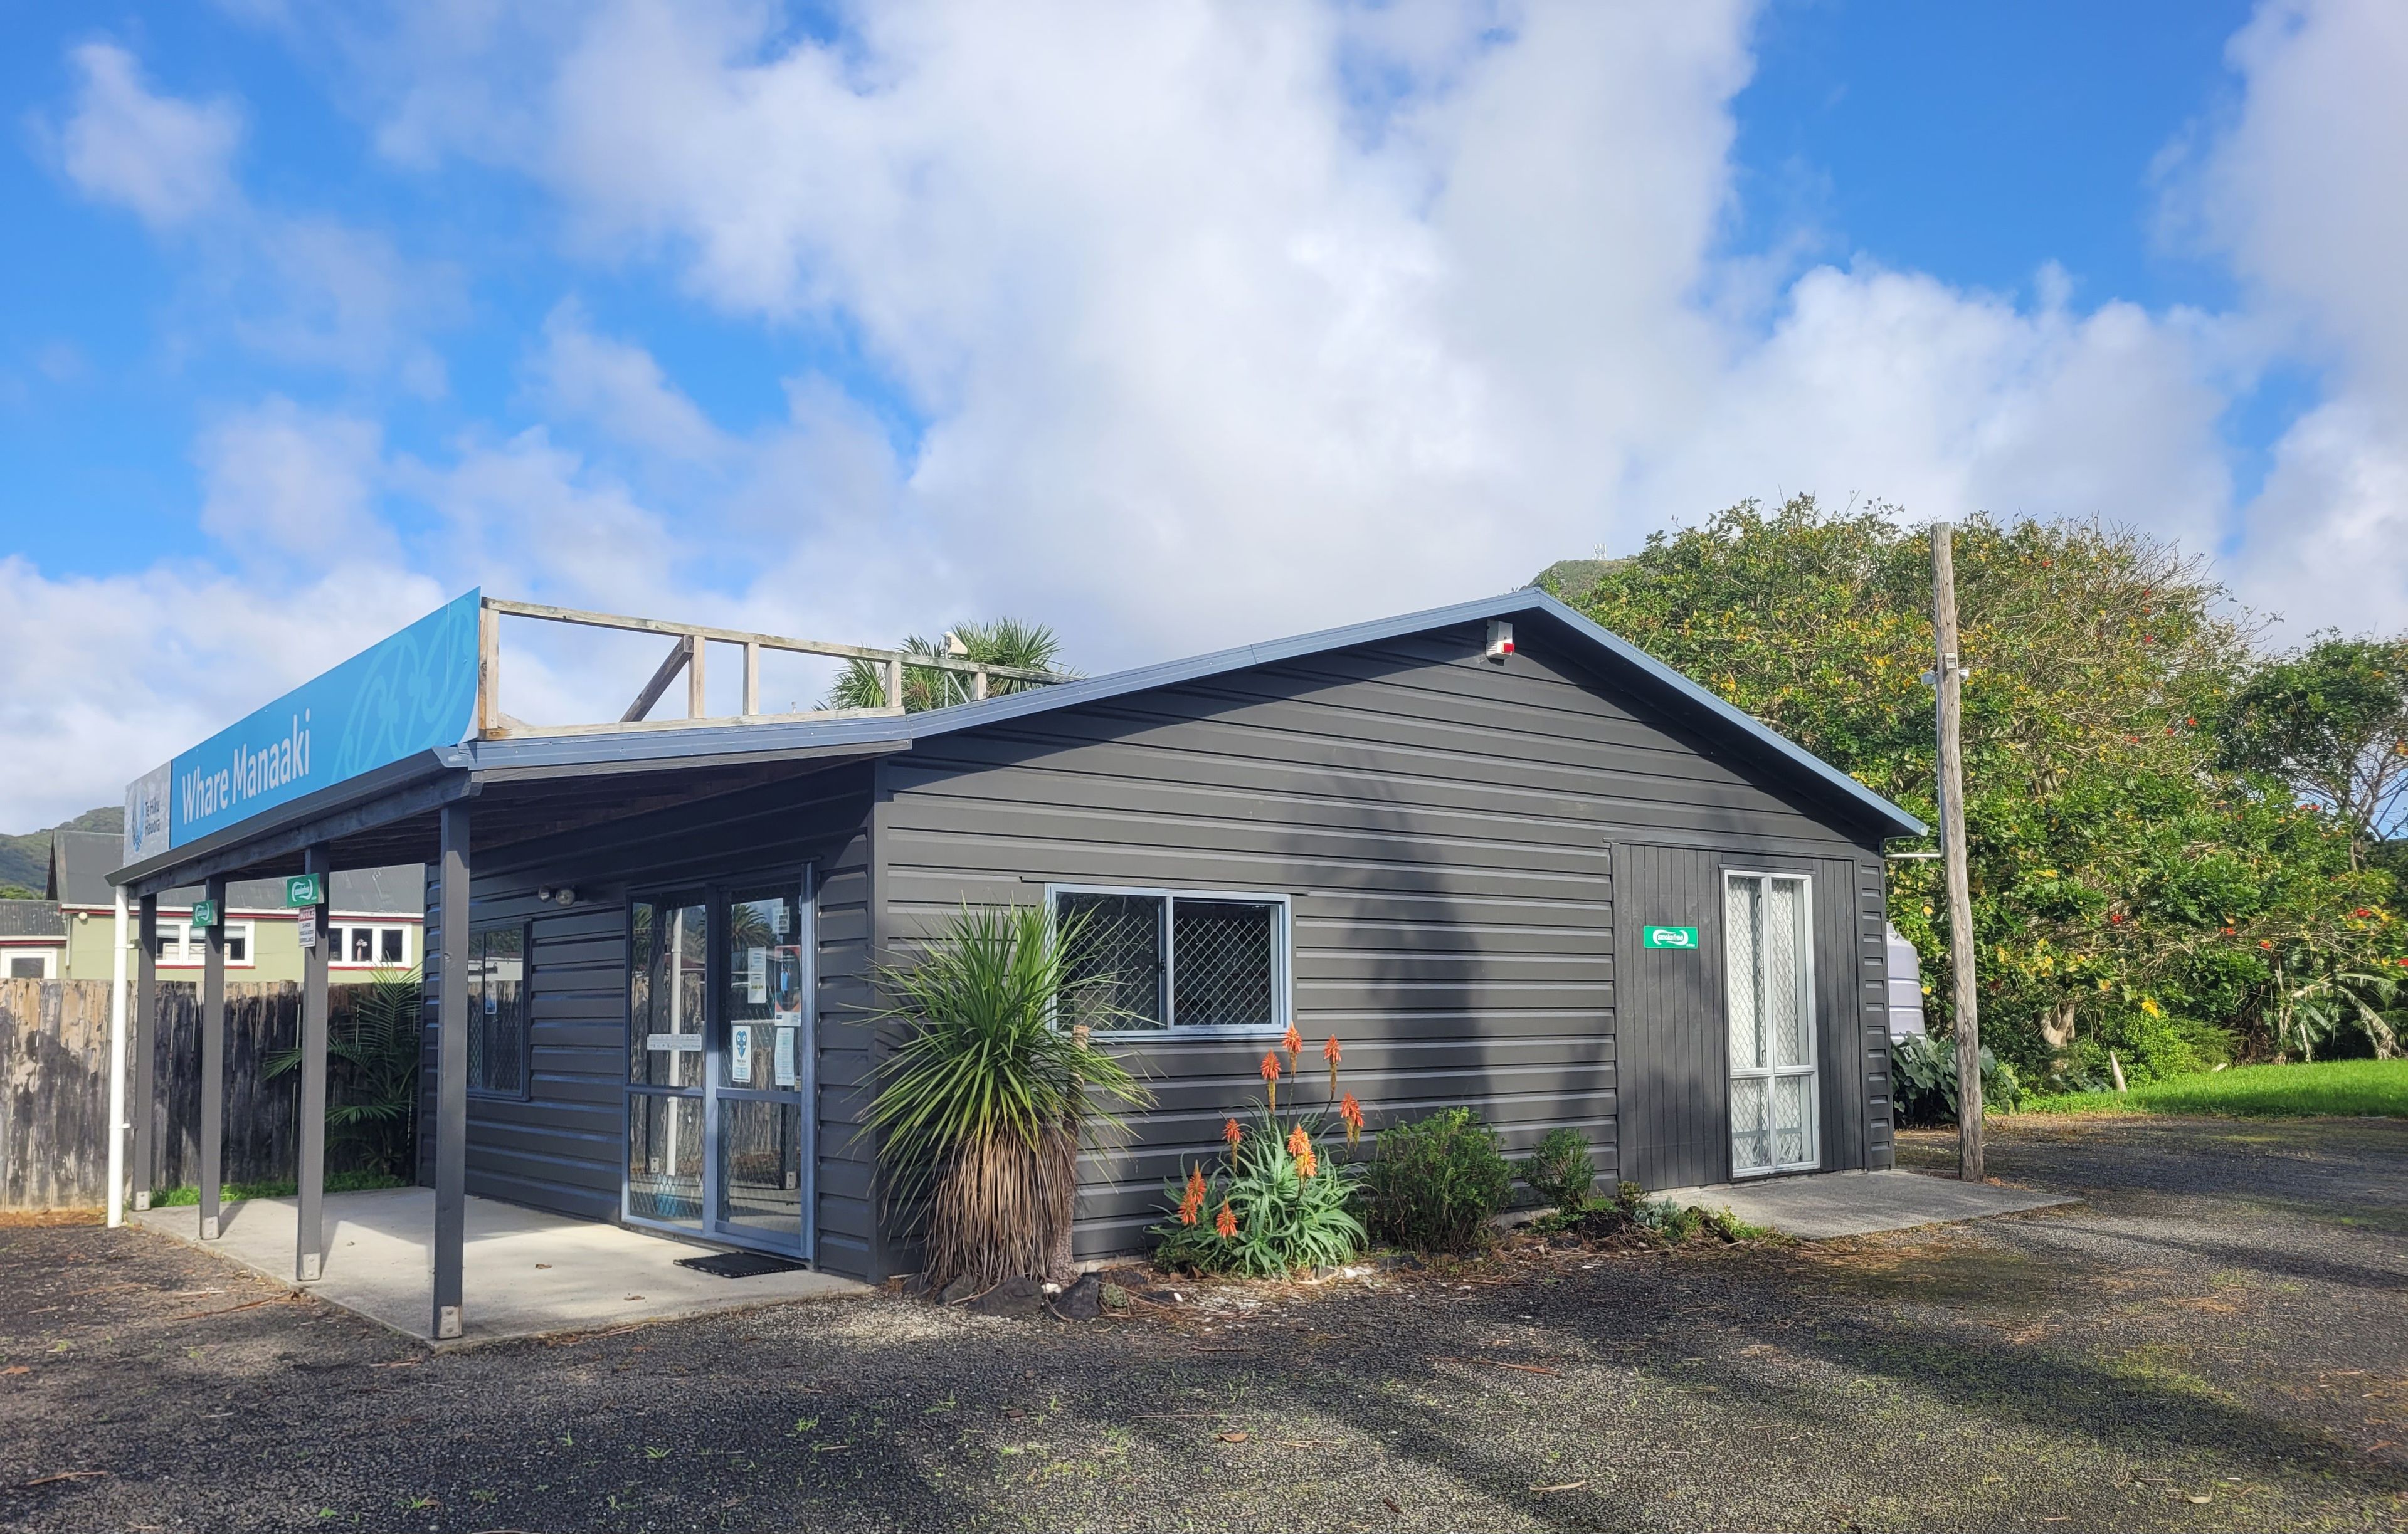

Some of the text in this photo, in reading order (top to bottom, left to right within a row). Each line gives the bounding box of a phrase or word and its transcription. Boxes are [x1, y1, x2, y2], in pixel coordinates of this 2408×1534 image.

[182, 707, 310, 825] Whare Manaaki
[145, 801, 150, 817] Te
[145, 819, 161, 837] Hauora
[299, 908, 315, 921] NOTICE
